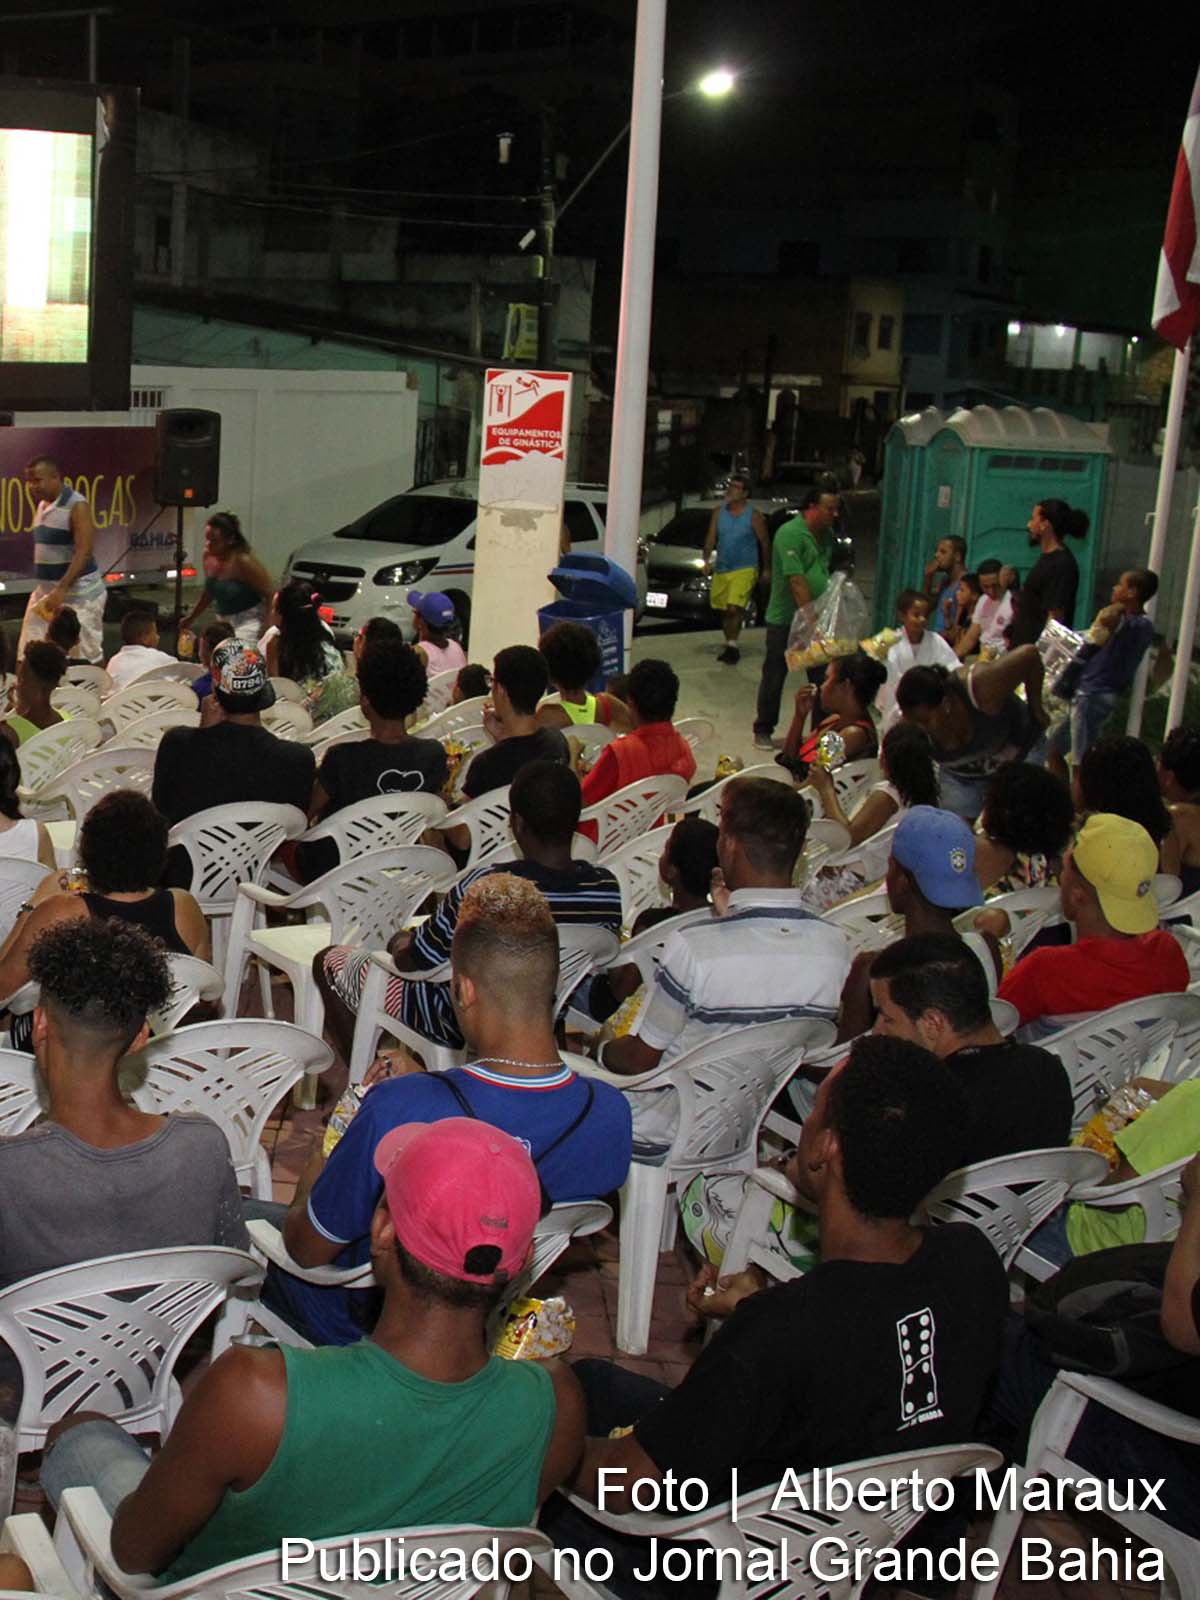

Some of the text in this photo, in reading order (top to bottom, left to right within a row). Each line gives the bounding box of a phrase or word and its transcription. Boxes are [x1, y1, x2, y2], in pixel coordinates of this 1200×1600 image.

[492, 428, 561, 439] EQUIPAMENTOS
[498, 437, 561, 448] DE GINÁSTICA
